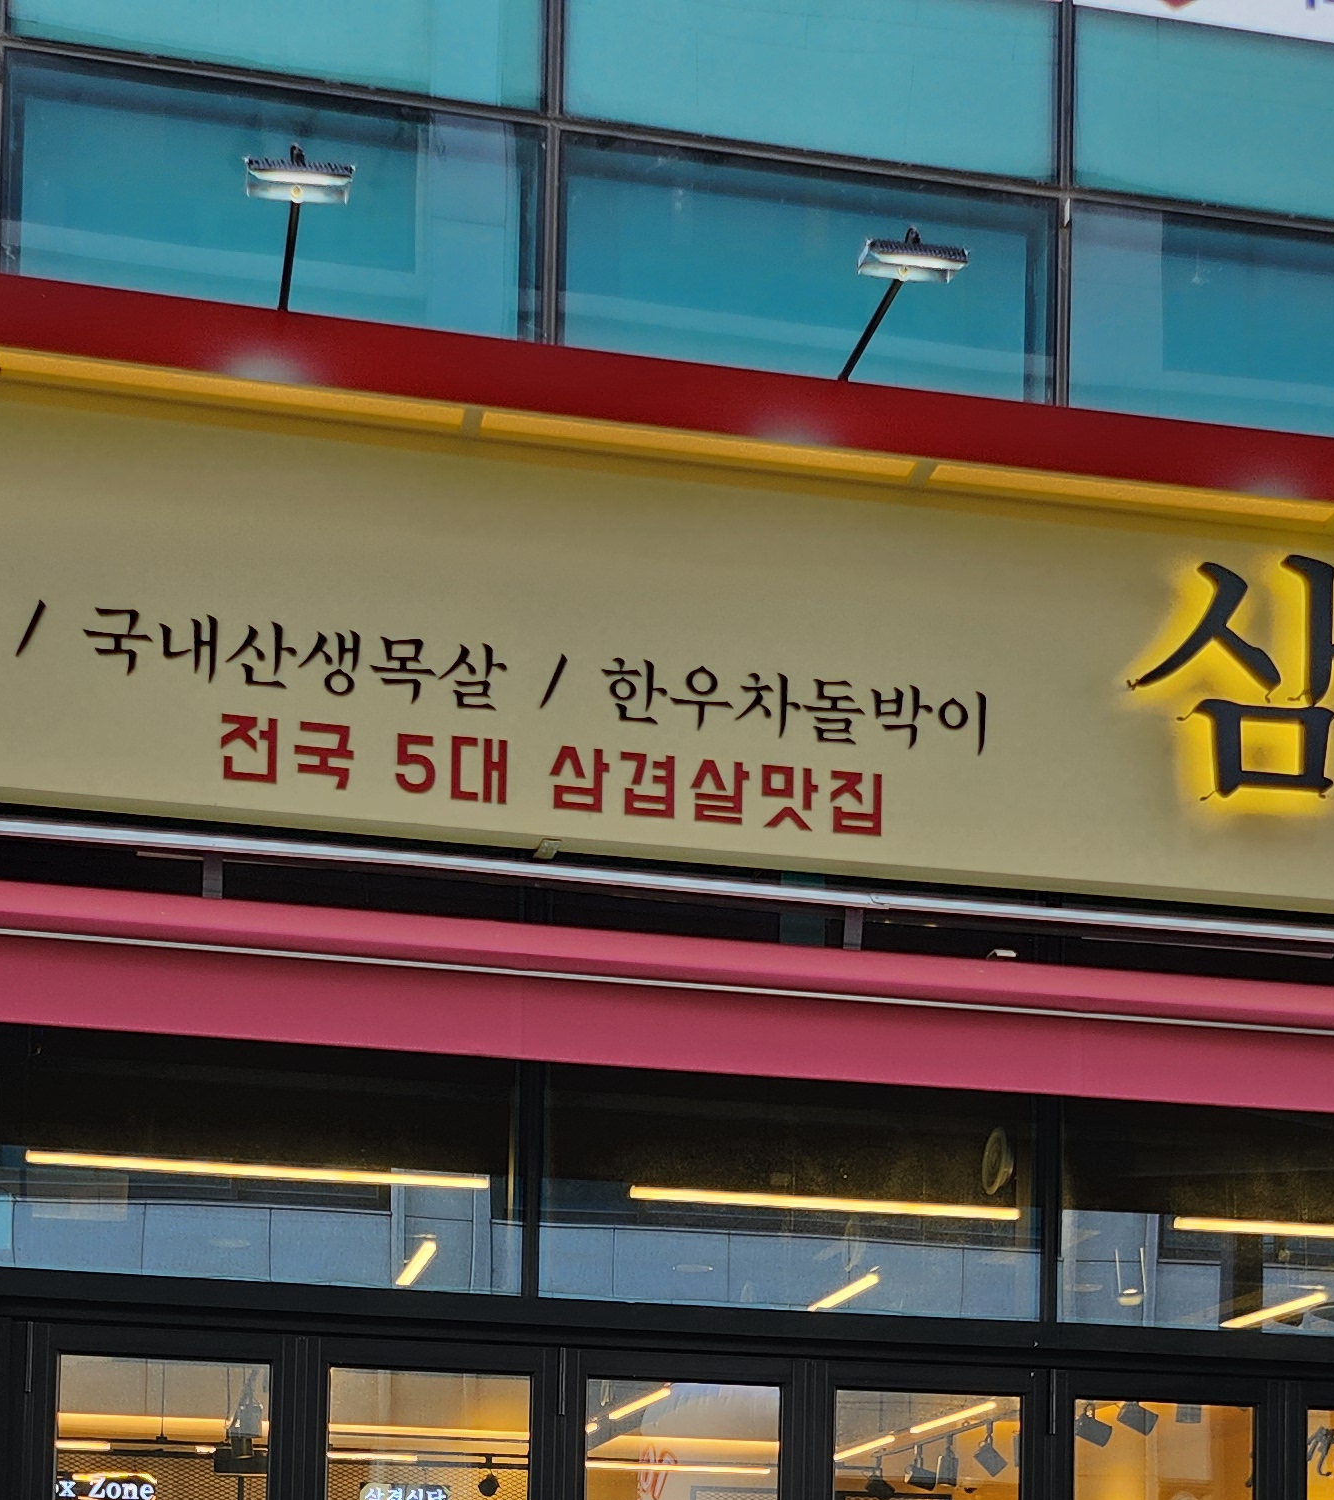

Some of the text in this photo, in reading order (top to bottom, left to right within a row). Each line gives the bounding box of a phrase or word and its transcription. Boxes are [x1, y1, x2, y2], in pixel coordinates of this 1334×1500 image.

[83, 605, 507, 712] 국내산생목살
[601, 655, 988, 757] 한우차돌박이
[220, 712, 884, 837] 전국 5대 삼겹살맛집
[88, 1477, 155, 1500] Zone
